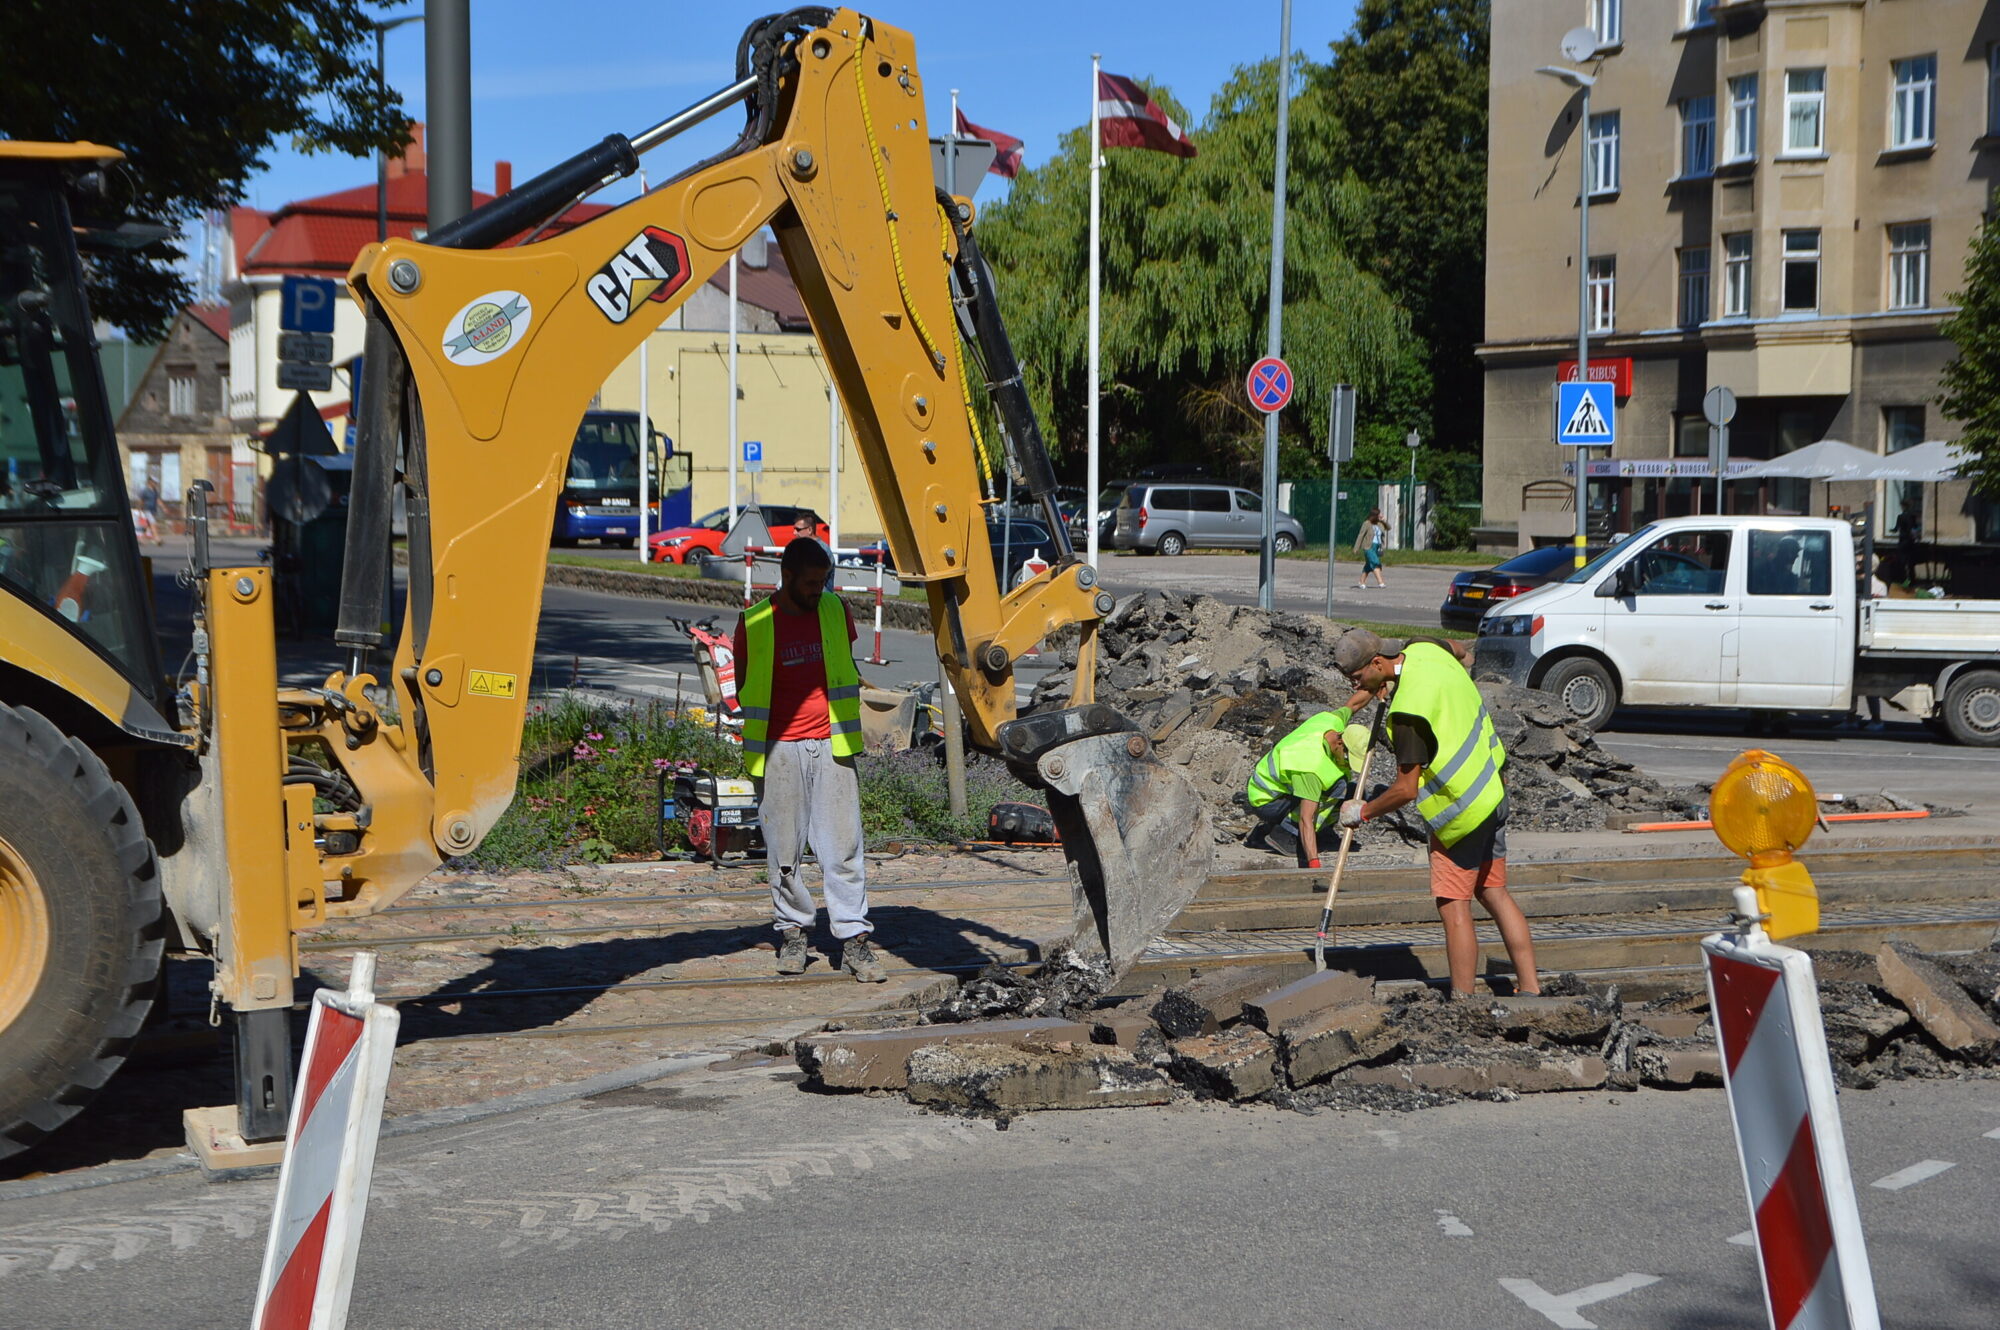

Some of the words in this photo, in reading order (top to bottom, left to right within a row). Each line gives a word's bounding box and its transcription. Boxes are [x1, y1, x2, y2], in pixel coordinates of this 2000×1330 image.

[588, 232, 669, 322] CAT
[294, 284, 326, 327] P
[472, 317, 507, 344] A-LAND
[747, 443, 758, 460] P
